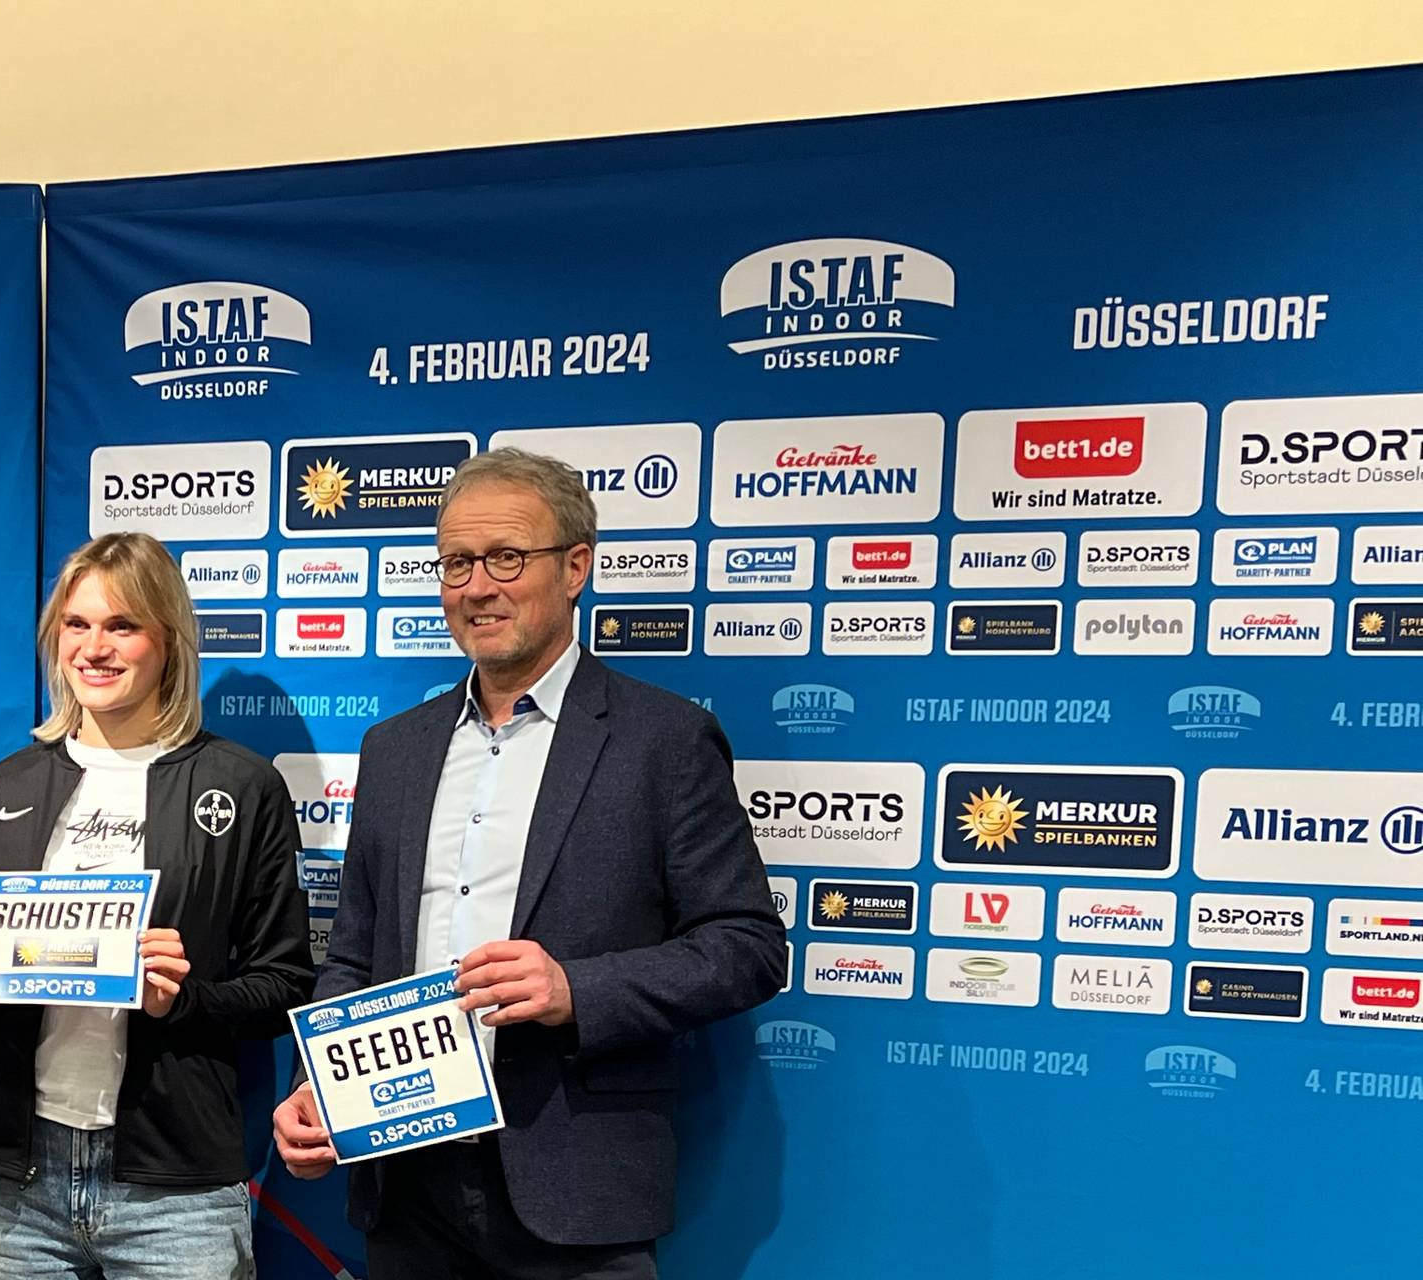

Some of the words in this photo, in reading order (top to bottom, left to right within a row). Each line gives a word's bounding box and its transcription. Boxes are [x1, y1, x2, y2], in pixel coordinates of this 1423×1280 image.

[768, 253, 904, 311] ISTAF
[162, 296, 269, 346] ISTAF
[766, 310, 901, 333] INDOOR
[1074, 295, 1328, 349] DÜSSELDORF
[162, 346, 269, 367] INDOOR
[369, 348, 397, 385] 4.
[410, 339, 551, 383] FEBRUAR
[563, 334, 649, 375] 2024
[765, 347, 900, 369] DÜSSELDORF
[161, 380, 268, 400] DÜSSELDORF
[775, 444, 877, 469] Getränke
[1024, 437, 1133, 459] bett1.de
[105, 470, 254, 500] D.SPORTS
[736, 468, 916, 498] HOFFMANN
[1240, 469, 1350, 488] Sportstadt
[993, 491, 1022, 508] Wir
[1028, 489, 1066, 507] sind
[1073, 489, 1161, 506] Matratze.
[105, 504, 177, 520] Sportstadt
[182, 501, 254, 515] Düsseldorf
[755, 550, 795, 562] PLAN
[856, 549, 907, 562] bett1.de
[1088, 546, 1189, 562] D.SPORTS
[1268, 542, 1313, 554] PLAN
[601, 554, 688, 569] D.SPORTS
[960, 552, 1026, 568] Allianz
[188, 568, 238, 581] Allianz
[287, 572, 358, 584] HOFFMANN
[842, 575, 856, 583] Wir
[859, 575, 877, 583] sind
[879, 575, 919, 583] Matratze.
[631, 628, 677, 638] MONHEIM
[632, 622, 684, 632] SPIELBANK
[714, 622, 775, 636] Allianz
[831, 617, 925, 632] D.SPORTS
[1085, 614, 1182, 640] polytan
[1221, 627, 1319, 640] HOFFMANN
[221, 696, 265, 715] ISTAF
[269, 694, 330, 719] INDOOR
[336, 696, 379, 717] 2024
[907, 699, 964, 721] ISTAF
[971, 699, 1047, 722] INDOOR
[1055, 700, 1110, 723] 2024
[1036, 802, 1156, 823] MERKUR
[812, 825, 902, 841] Düsseldorf
[1222, 808, 1369, 843] Allianz
[1035, 832, 1156, 846] SPIELBANKEN
[40, 878, 112, 891] DÜSSELDORF
[112, 880, 144, 892] 2024
[853, 898, 906, 908] MERKUR
[1090, 904, 1143, 915] Getränke
[1069, 915, 1162, 931] HOFFMANN
[1199, 908, 1303, 927] D.SPORTS
[816, 968, 902, 984] HOFFMANN
[6, 978, 95, 997] D.SPORTS
[1355, 985, 1415, 999] bett1.de
[347, 987, 420, 1021] DÜSSELDORF
[422, 981, 455, 1003] 2024
[1071, 990, 1151, 1005] DÜSSELDORF
[326, 1015, 458, 1081] SEEBER
[888, 1041, 944, 1065] ISTAF
[951, 1045, 1026, 1072] INDOOR
[1034, 1051, 1089, 1076] 2024
[395, 1072, 431, 1094] PLAN
[369, 1111, 457, 1148] D.SPORTS
